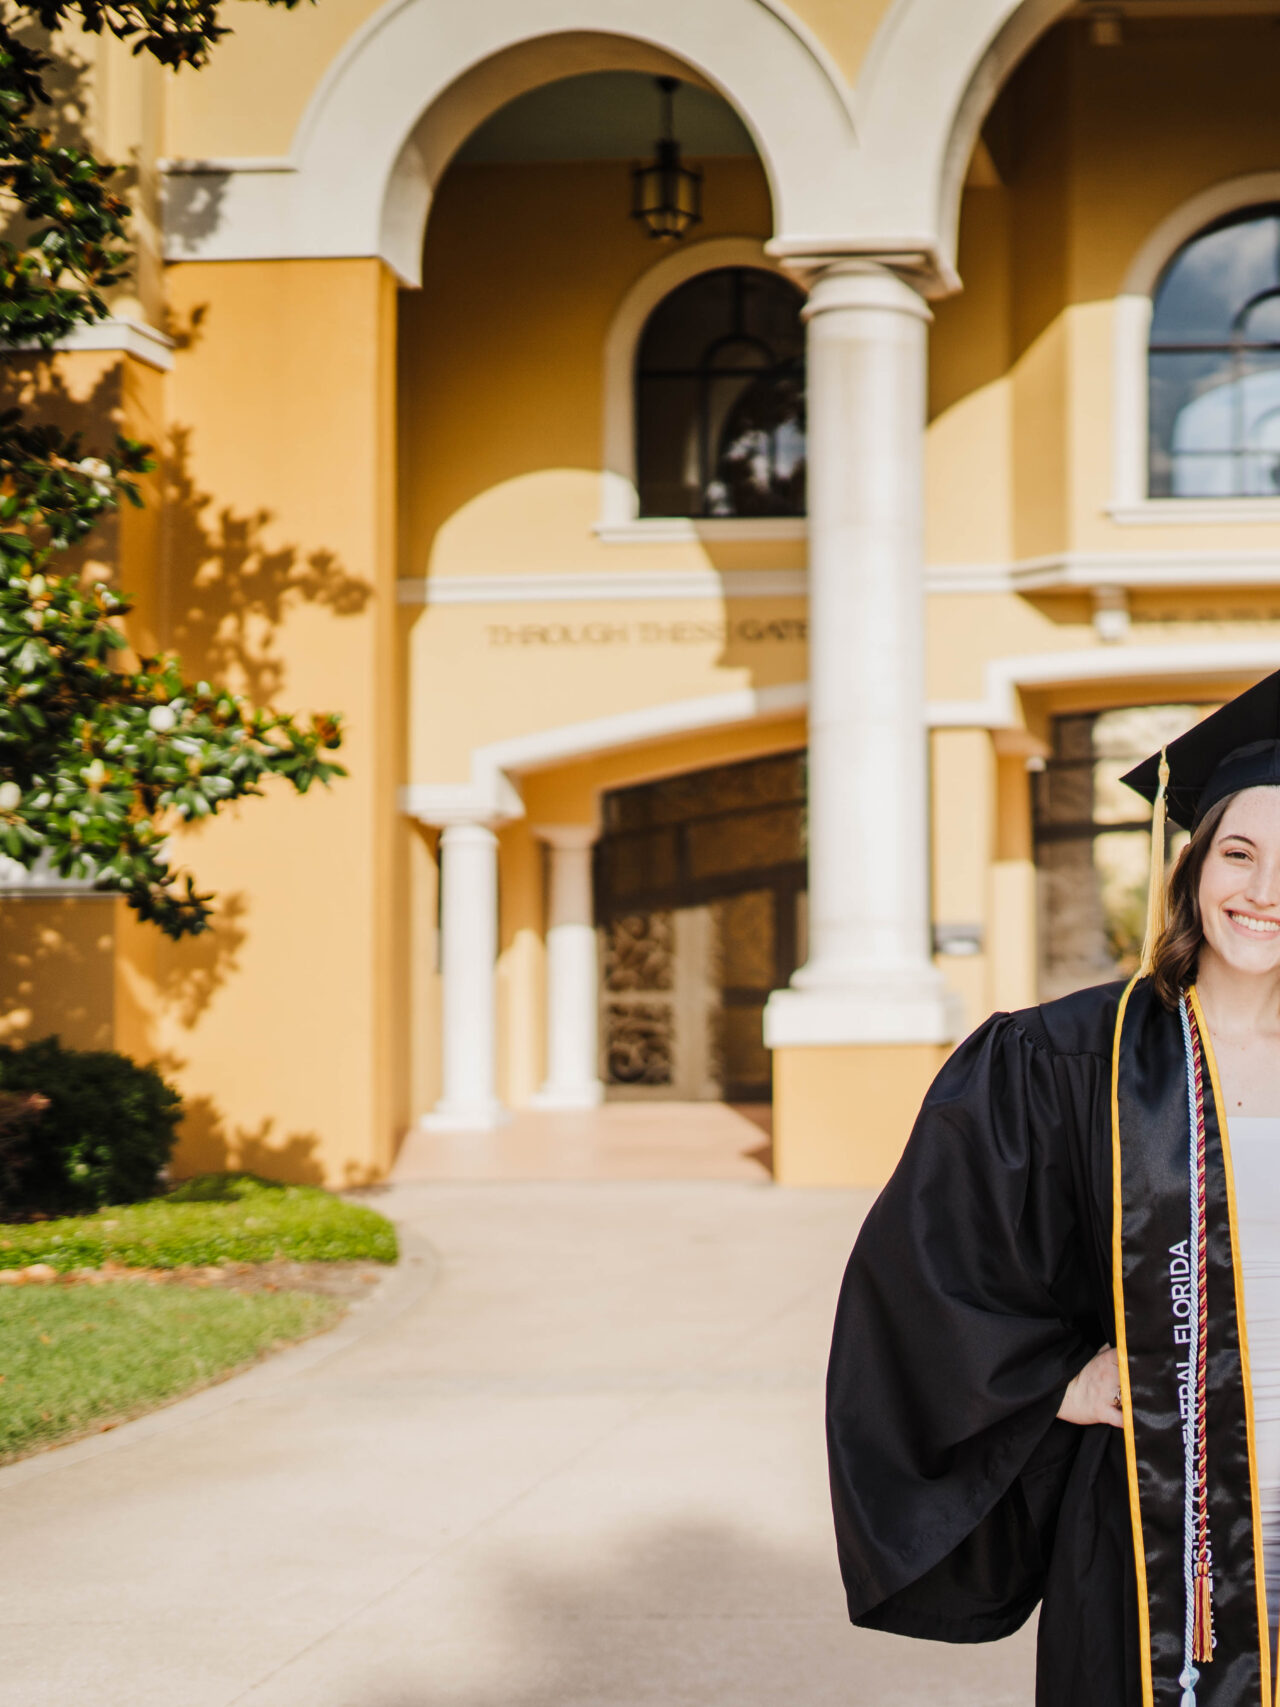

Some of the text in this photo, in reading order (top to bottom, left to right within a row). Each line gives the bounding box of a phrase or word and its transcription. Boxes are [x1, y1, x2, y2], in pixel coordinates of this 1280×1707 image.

[485, 623, 628, 646] THROUGH
[737, 617, 809, 642] GATE
[1168, 1239, 1194, 1345] FLORIDA
